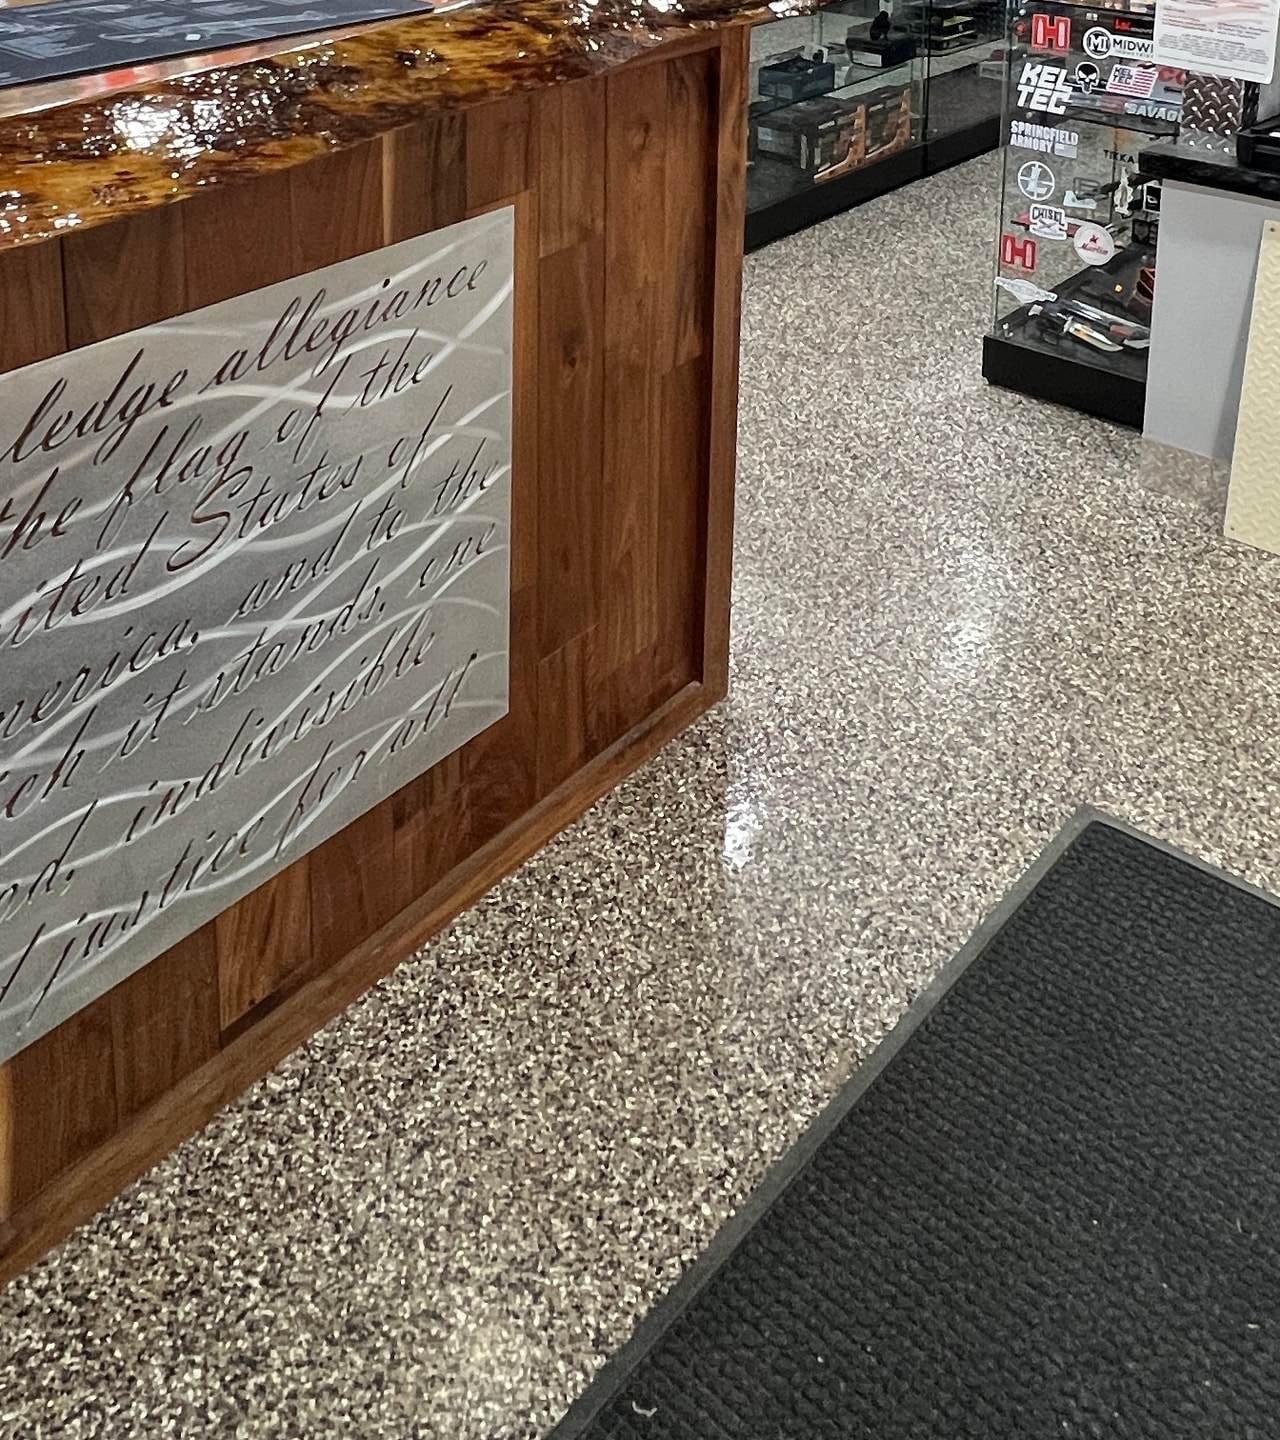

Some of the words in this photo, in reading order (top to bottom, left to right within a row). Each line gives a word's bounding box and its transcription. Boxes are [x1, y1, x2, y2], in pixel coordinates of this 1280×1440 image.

[1010, 120, 1079, 146] SPRINGFIELD
[1010, 134, 1053, 154] ARMORY
[1016, 85, 1073, 115] TEC
[1019, 62, 1072, 91] KEL
[1124, 102, 1184, 121] SAVAG
[1104, 149, 1135, 162] TIKKA
[199, 258, 489, 394] allegiance
[97, 423, 253, 551] flag
[267, 355, 353, 458] of
[345, 328, 434, 410] the
[167, 454, 361, 572] States
[387, 385, 454, 491] of
[232, 501, 362, 621] and
[364, 498, 409, 547] to
[430, 437, 496, 518] the
[112, 670, 187, 766] it
[417, 522, 497, 596] one
[123, 610, 436, 846] indivisible
[18, 814, 267, 1036] justice
[275, 741, 369, 860] for
[378, 652, 478, 765] all
